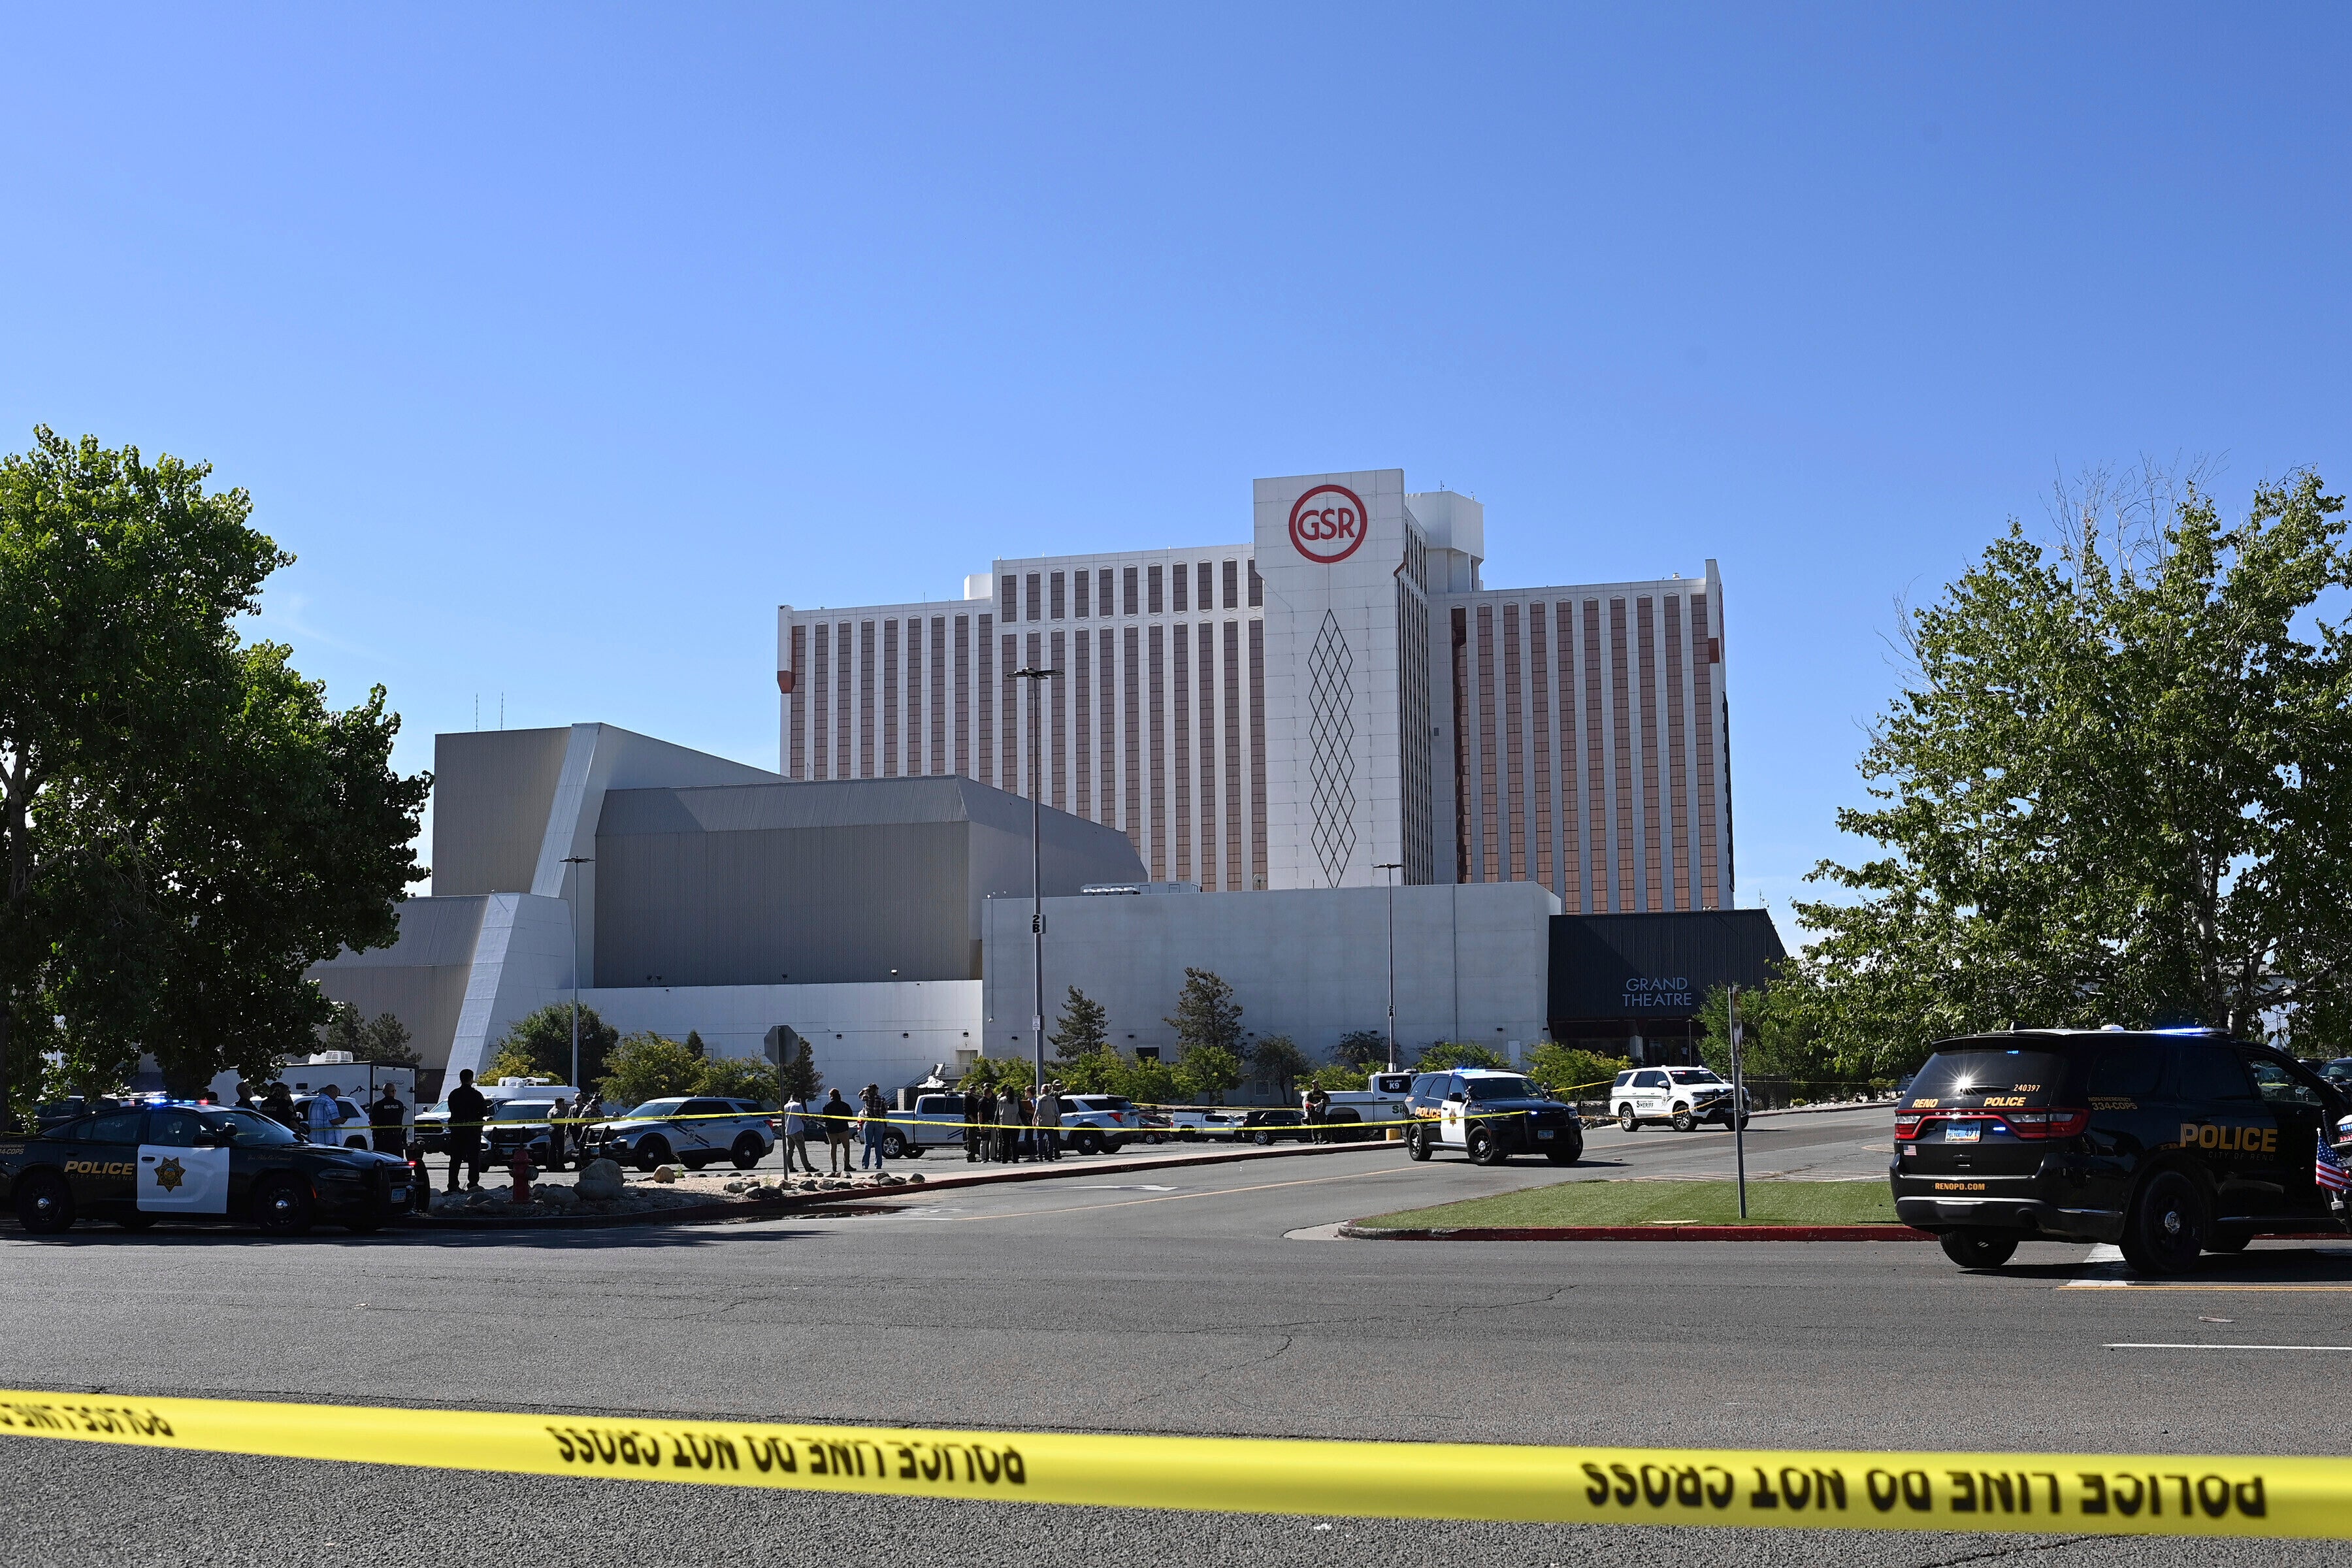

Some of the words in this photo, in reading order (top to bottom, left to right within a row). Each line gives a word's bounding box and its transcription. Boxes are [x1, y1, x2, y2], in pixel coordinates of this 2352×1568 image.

[1298, 508, 1356, 541] GSR
[1622, 993, 1692, 1007] THEATRE
[1625, 977, 1688, 992] GRAND
[1912, 1098, 1939, 1108] RENO
[1984, 1097, 2026, 1107] POLICE
[2014, 1084, 2040, 1092] 240397
[1414, 1107, 1443, 1119] POLICE
[2091, 1102, 2138, 1111] 334-COPS
[1965, 1127, 1978, 1137] 497
[2179, 1123, 2278, 1152] POLICE
[64, 1160, 135, 1175] POLICE
[545, 1426, 661, 1467] CROSS
[664, 1431, 739, 1470] NOT
[743, 1435, 797, 1474] DO
[796, 1437, 886, 1478] LINE
[886, 1441, 1026, 1485] POLICE
[1581, 1463, 1734, 1509] CROSS
[1750, 1465, 1848, 1510] NOT
[1867, 1468, 1932, 1512] DO
[1946, 1471, 2062, 1514] LINE
[2078, 1473, 2267, 1518] POLICE
